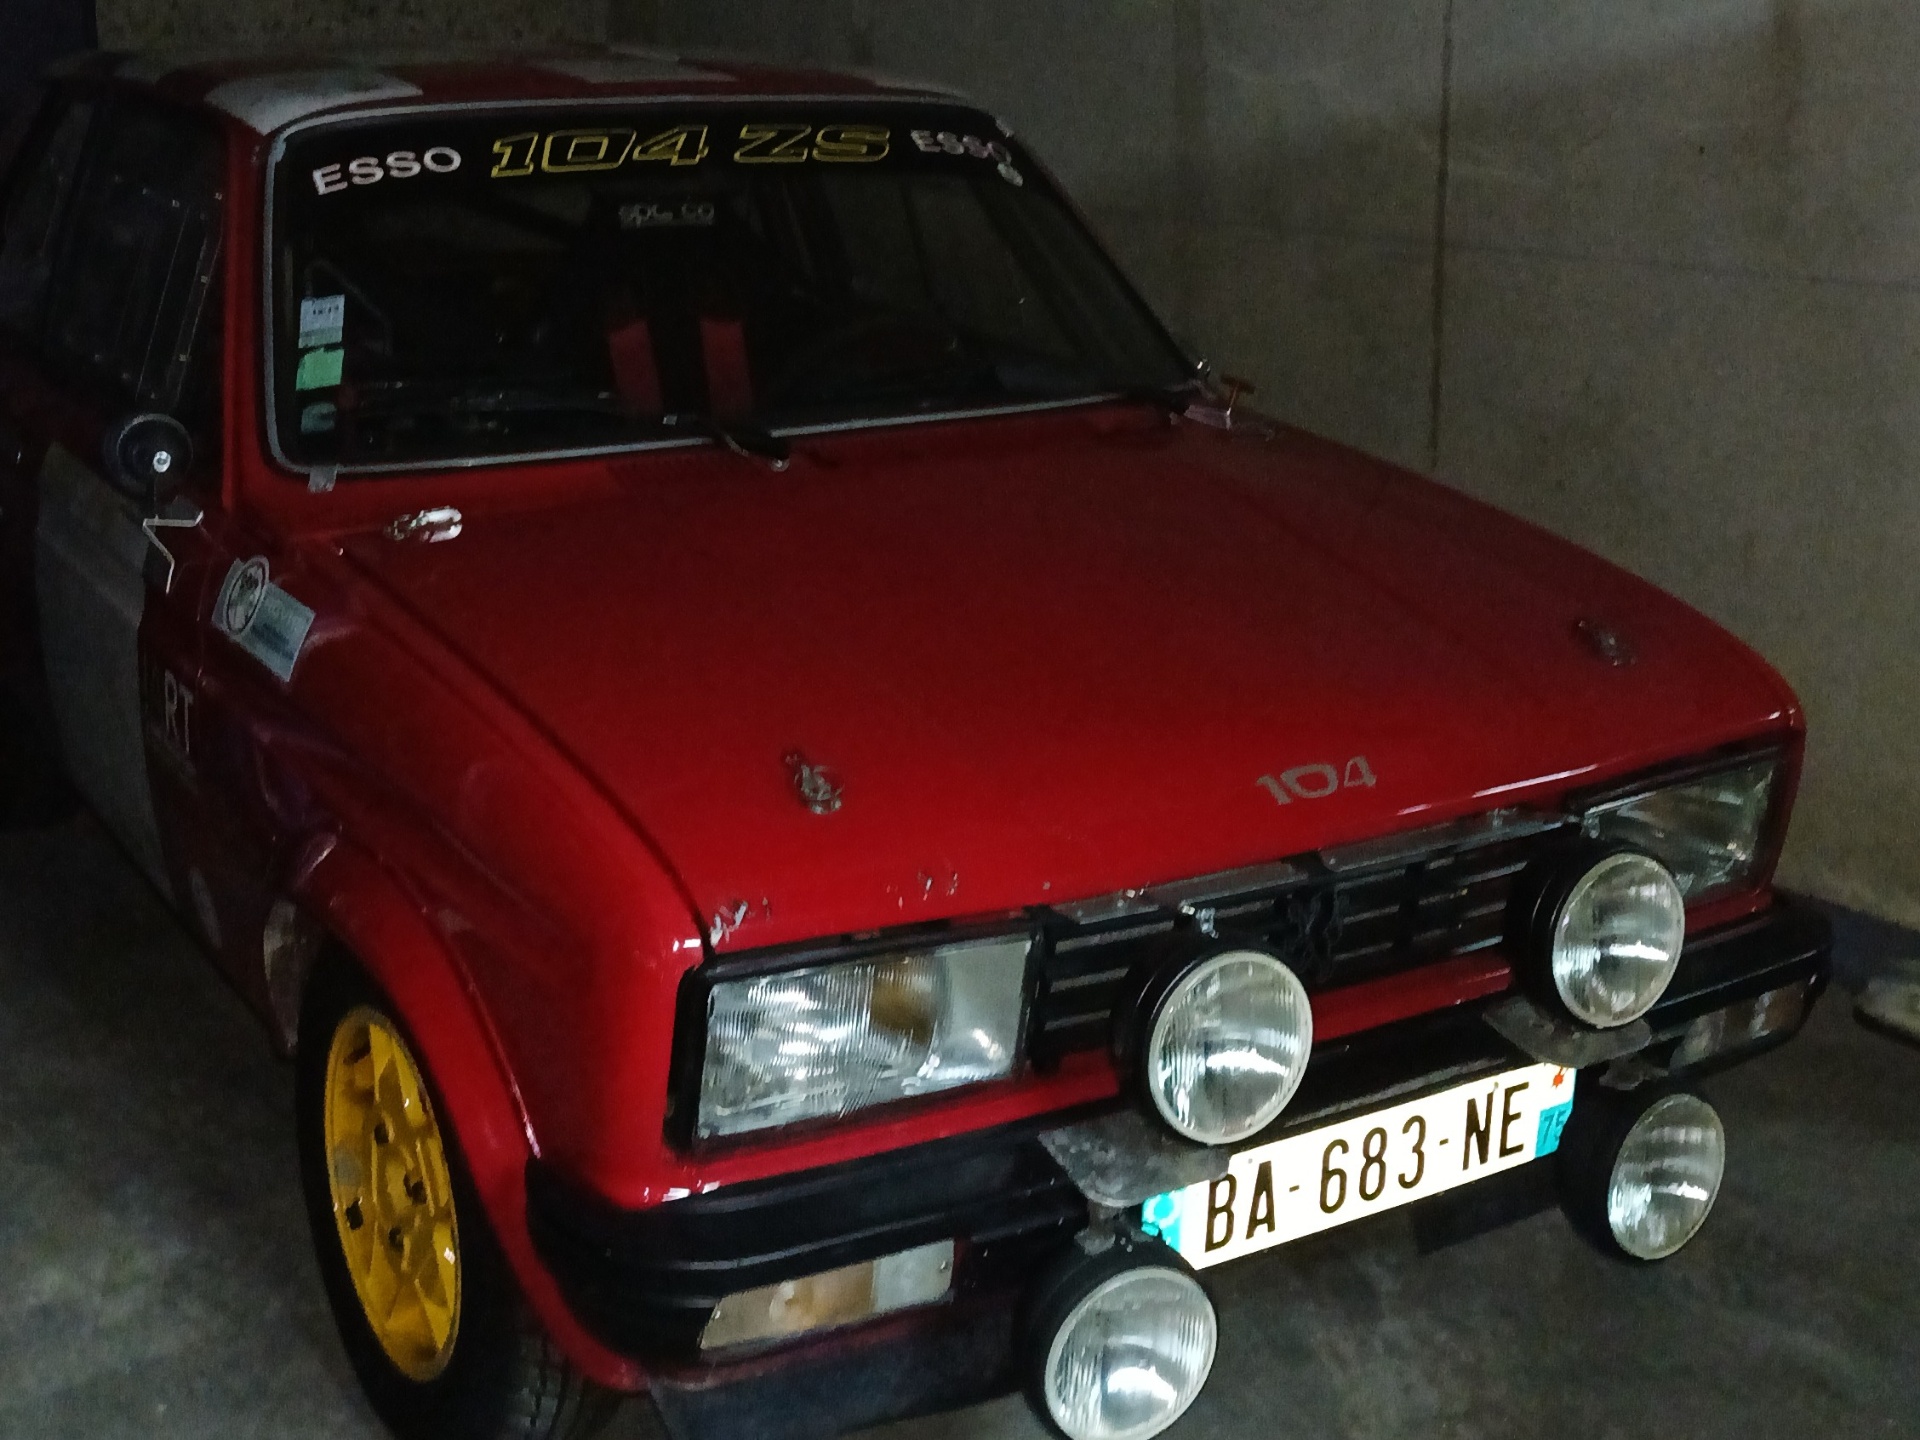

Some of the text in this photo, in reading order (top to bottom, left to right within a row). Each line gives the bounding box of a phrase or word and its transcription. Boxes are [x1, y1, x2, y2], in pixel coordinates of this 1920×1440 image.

[312, 146, 462, 196] ESSO
[490, 124, 890, 179] 104 ZS
[1255, 756, 1377, 805] 104
[1204, 1081, 1530, 1254] BA-683-NE
